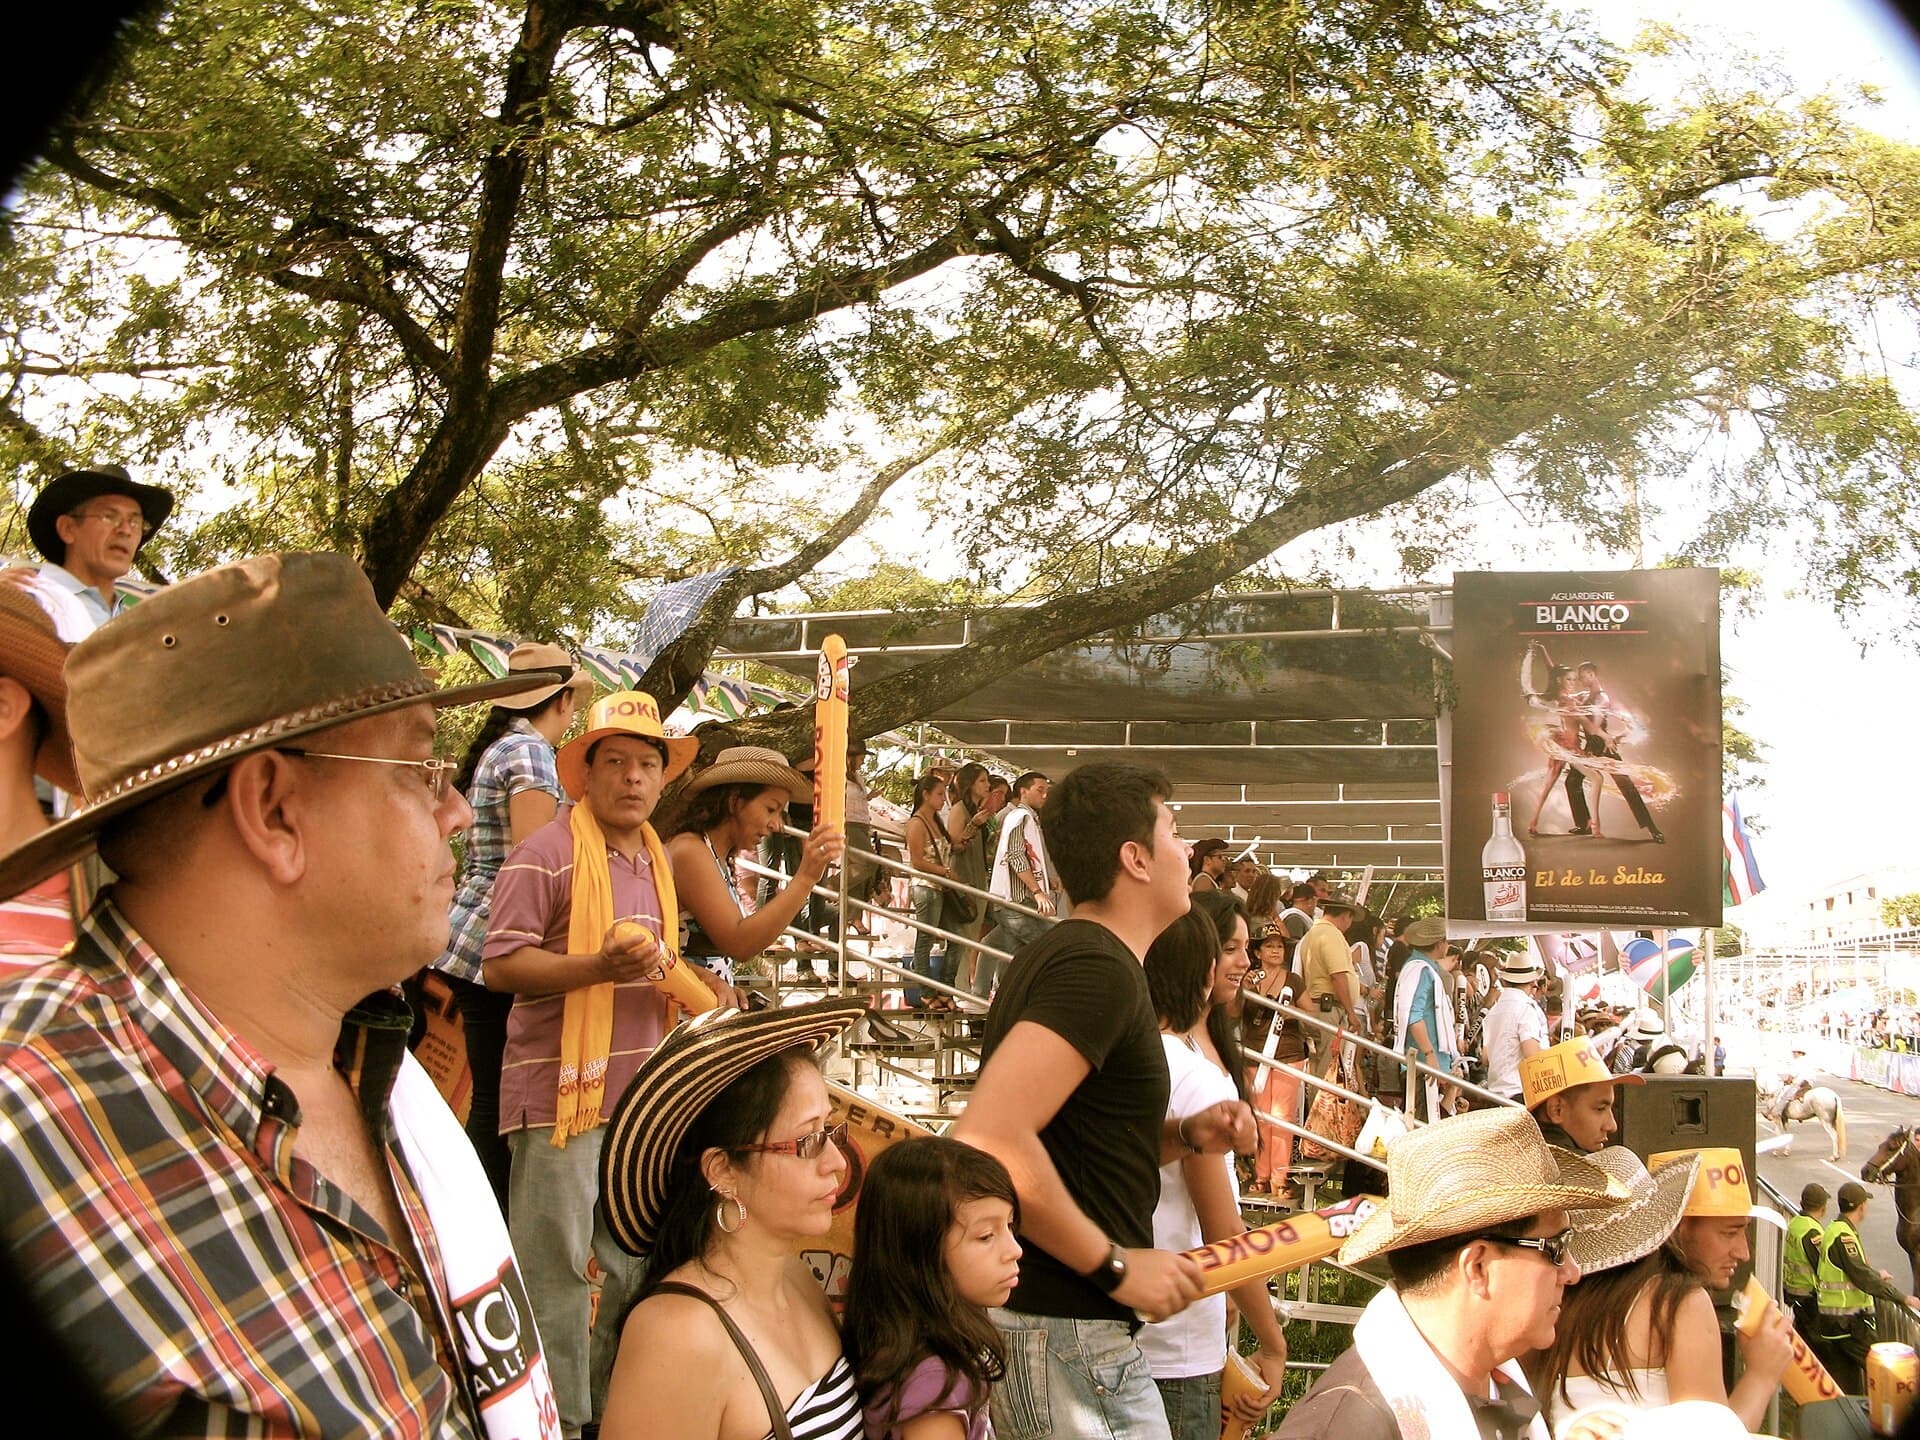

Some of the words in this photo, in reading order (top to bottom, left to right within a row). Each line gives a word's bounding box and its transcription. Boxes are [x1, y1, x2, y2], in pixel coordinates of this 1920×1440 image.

[1551, 592, 1615, 600] AGUARDIENTE
[1536, 604, 1630, 624] BLANCO
[1579, 623, 1609, 631] VALLE
[1483, 867, 1526, 878] BLANCO
[1535, 870, 1556, 887] El
[1560, 869, 1584, 886] de
[1588, 869, 1608, 885] la
[1613, 865, 1666, 885] Salsa
